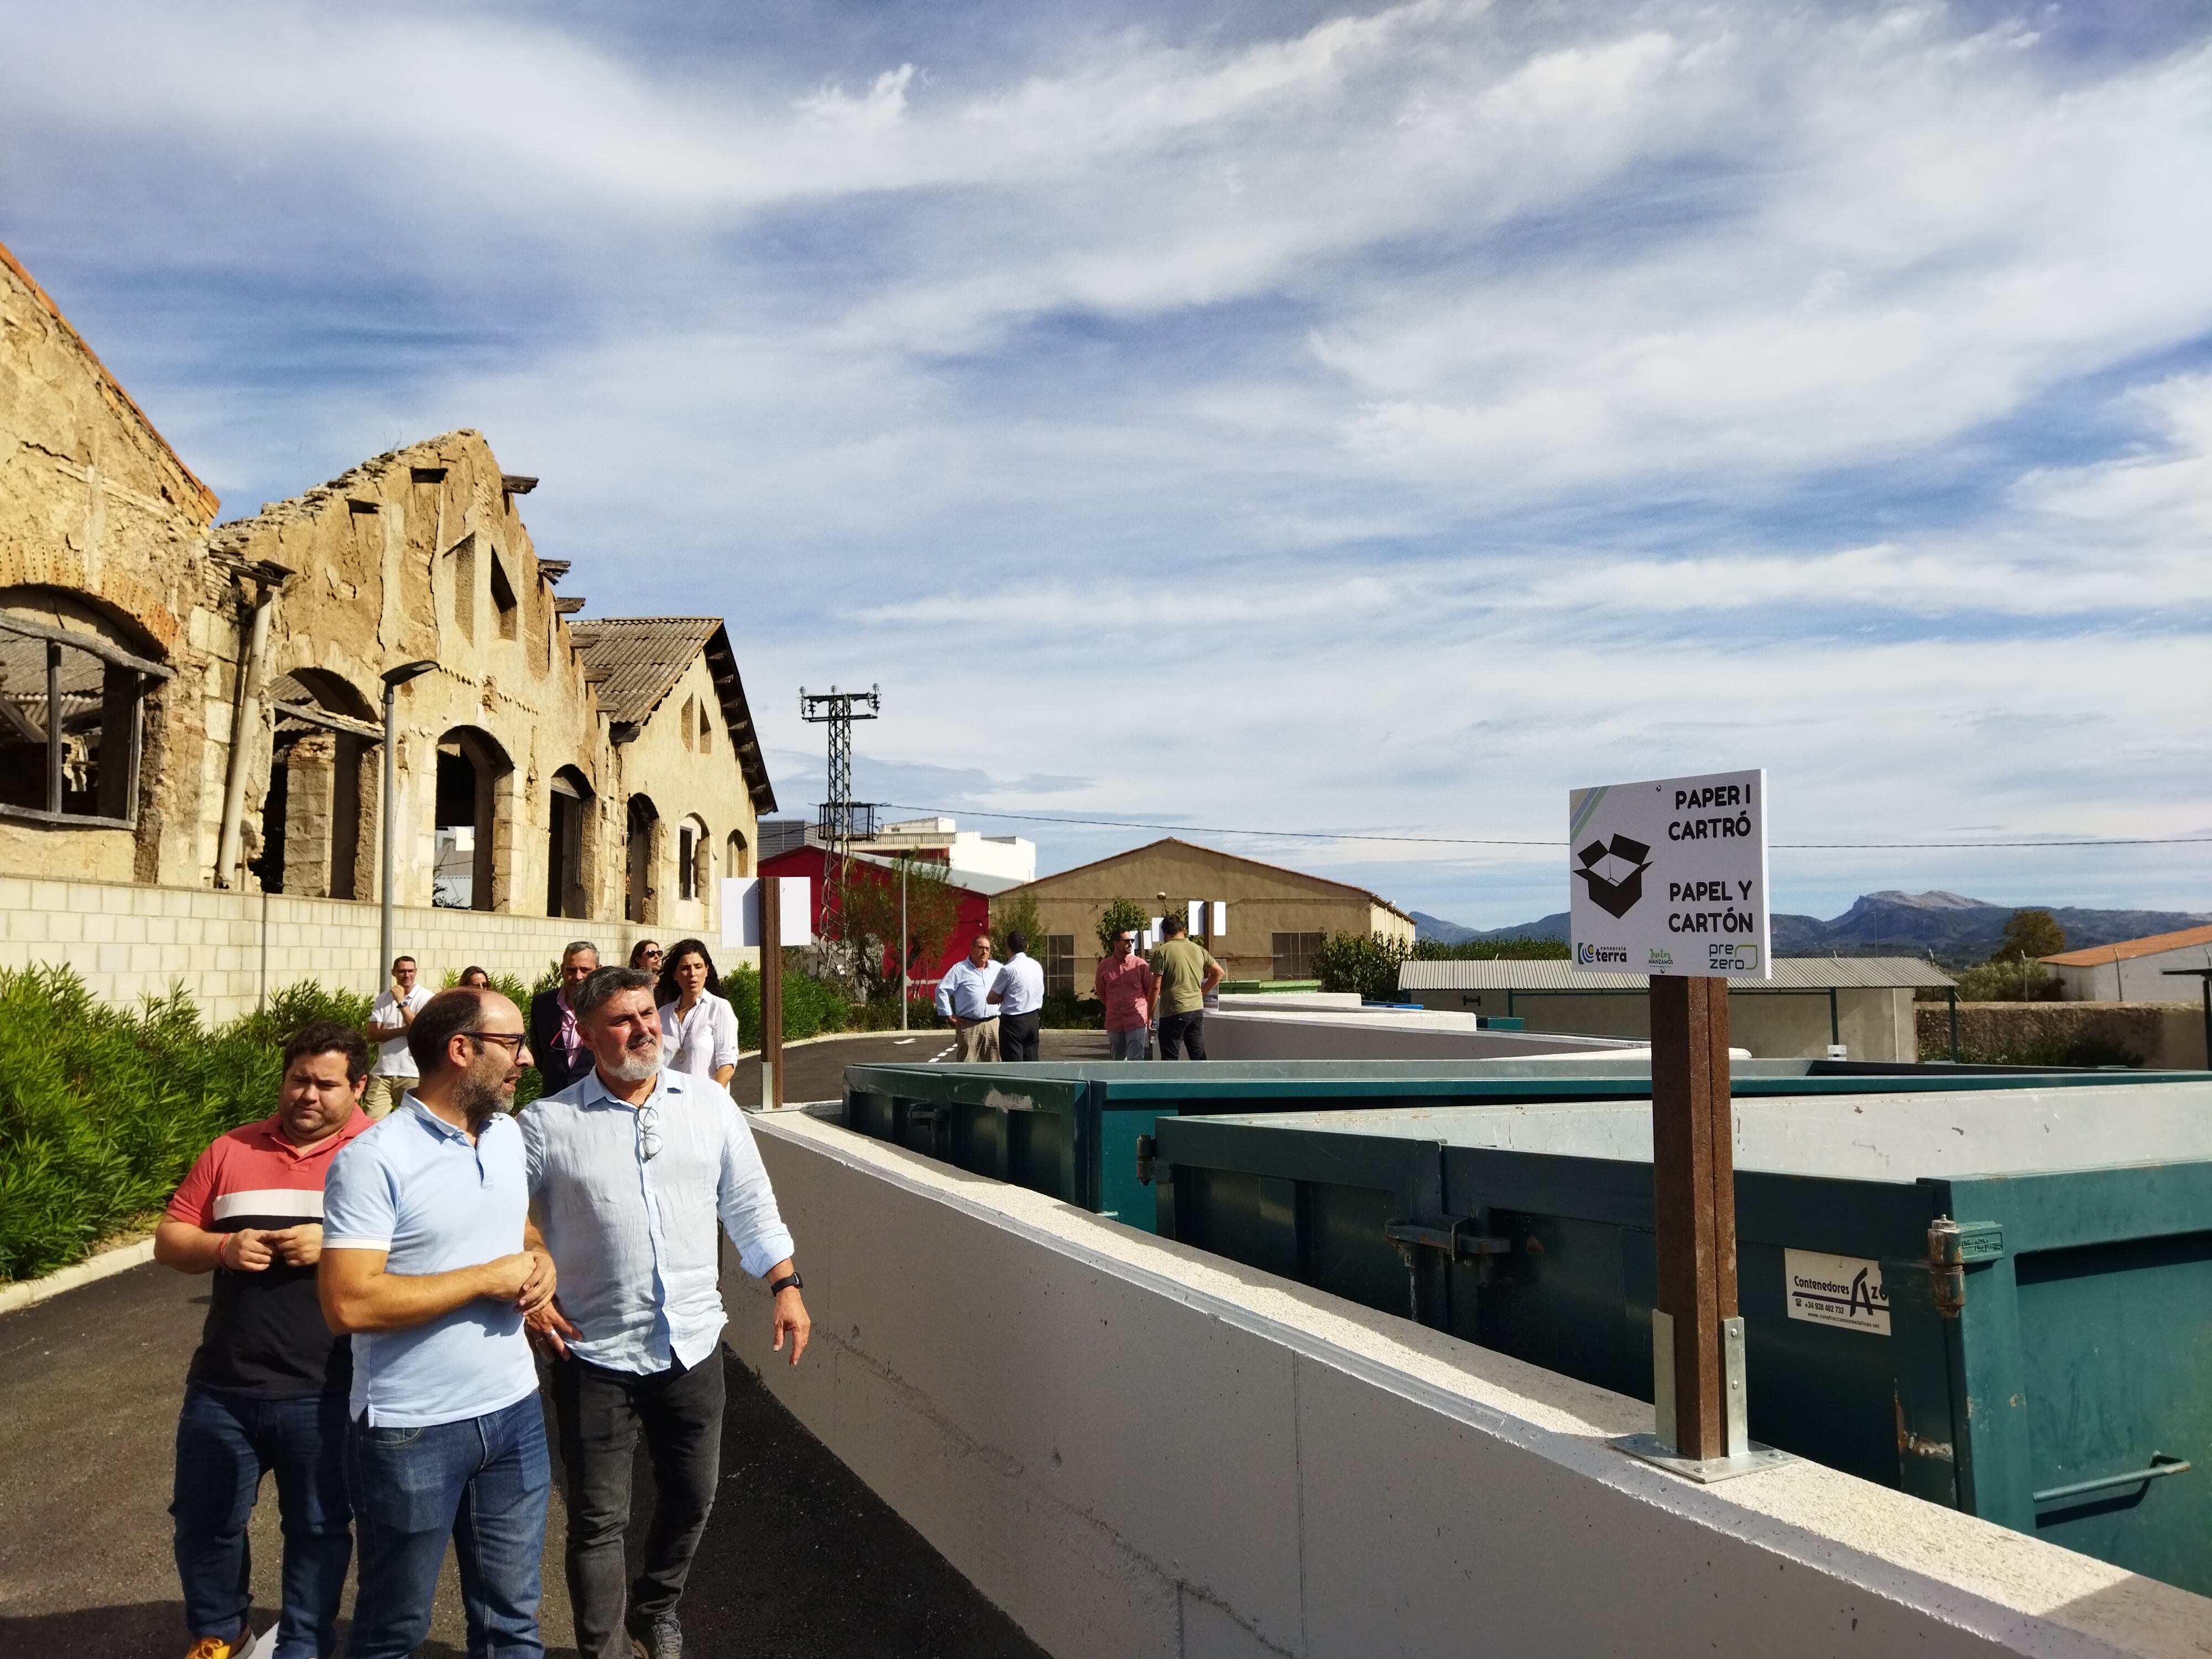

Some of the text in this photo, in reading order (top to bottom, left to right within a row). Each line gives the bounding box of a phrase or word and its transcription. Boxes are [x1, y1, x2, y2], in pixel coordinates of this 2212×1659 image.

[1675, 784, 1750, 810] PAPER I
[1668, 810, 1751, 841] CARTRÓ
[1670, 880, 1752, 901] PAPEL Y
[1668, 907, 1754, 933] CARTÓN
[1595, 948, 1627, 963] terra
[1709, 944, 1734, 957] pre
[1709, 959, 1744, 969] zero
[1794, 1275, 1850, 1295] Contenedores
[1805, 1301, 1844, 1314] +34 938 402 732
